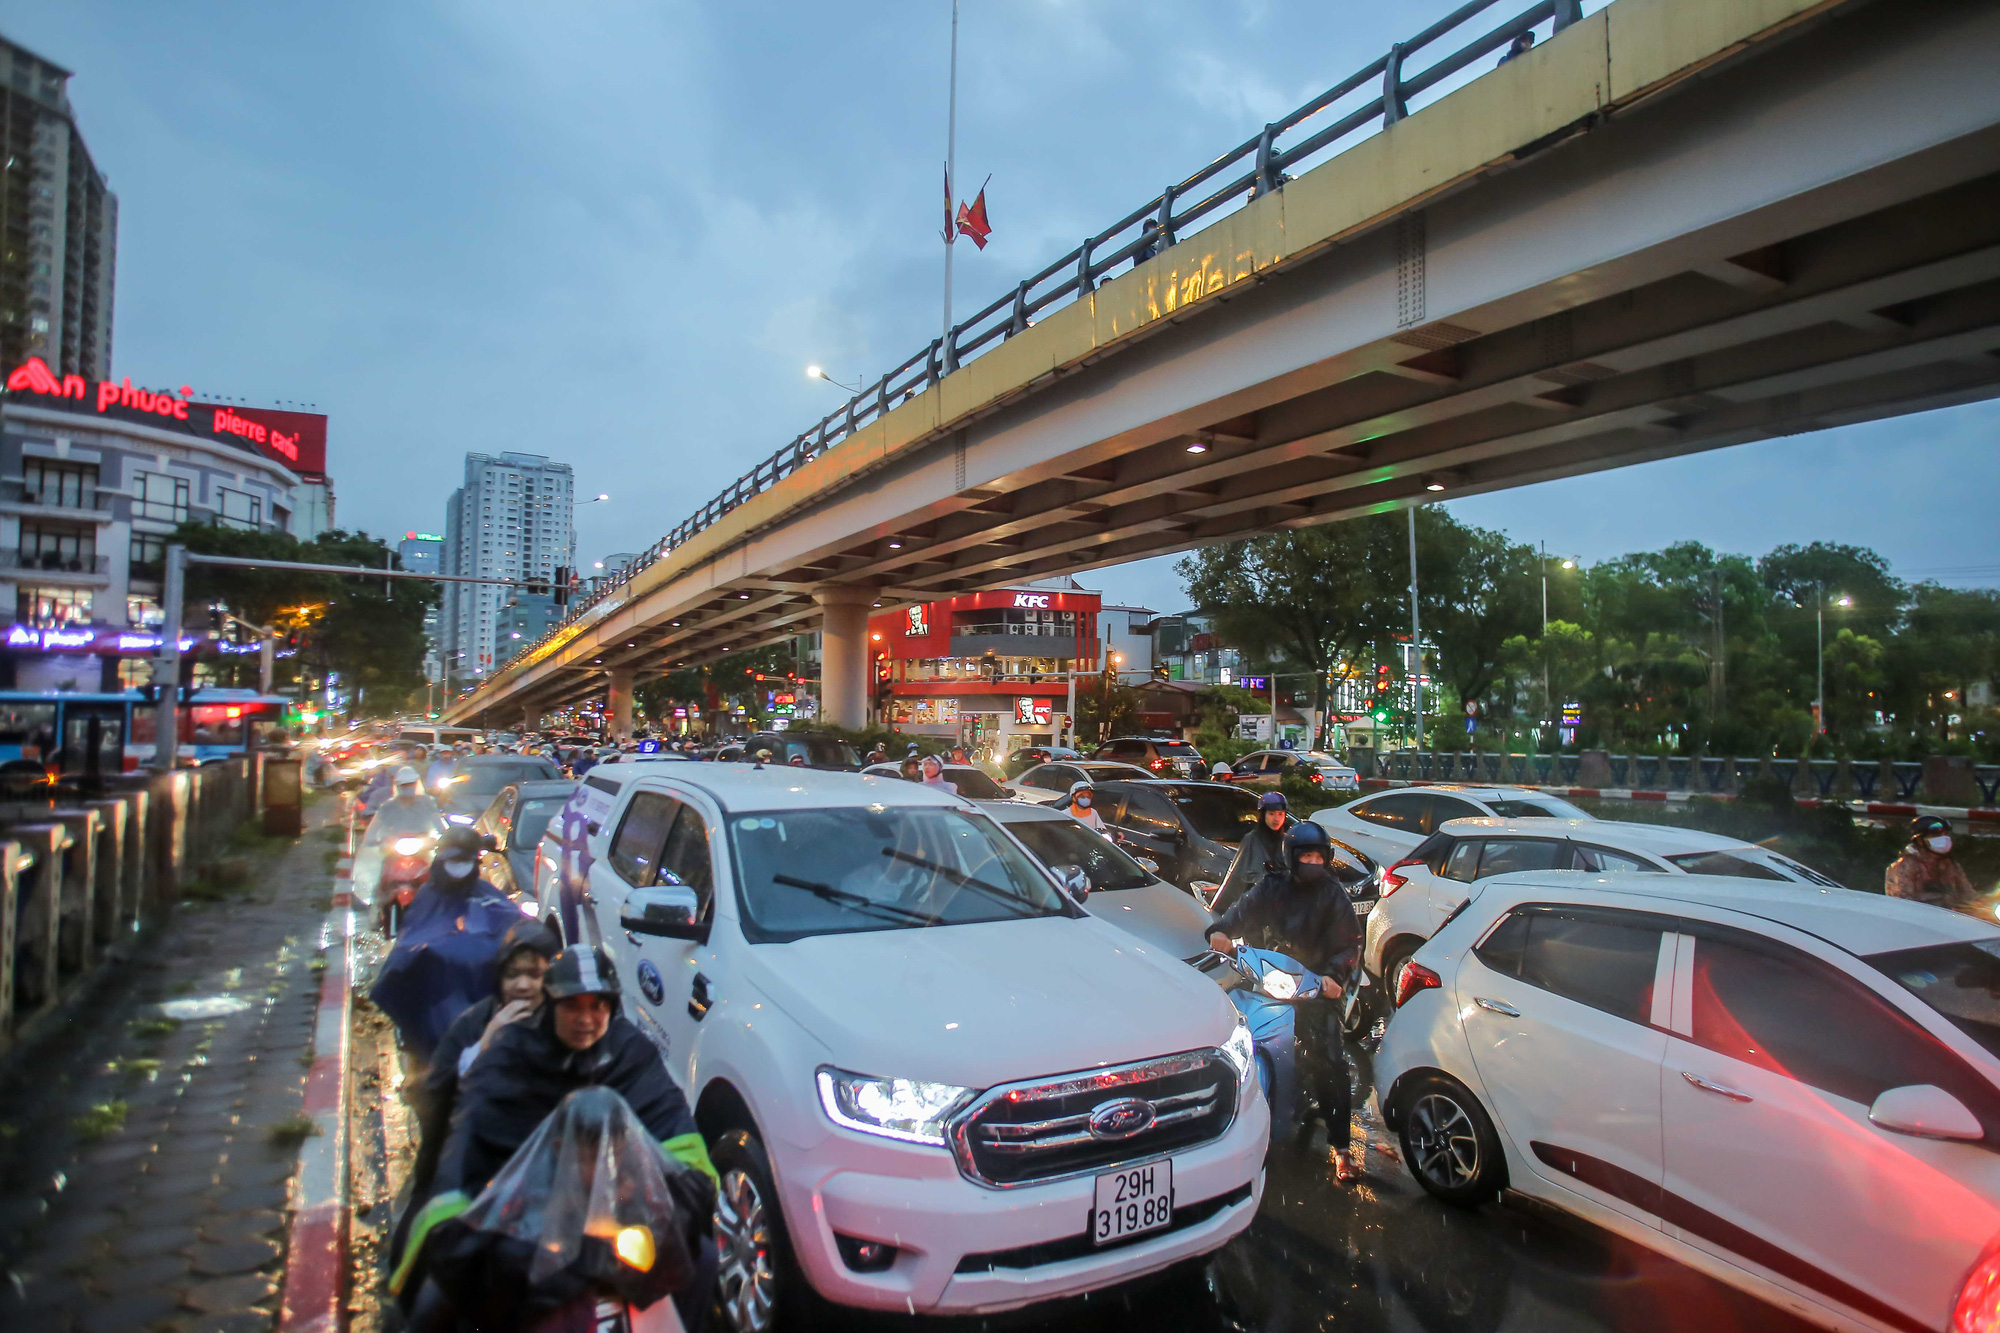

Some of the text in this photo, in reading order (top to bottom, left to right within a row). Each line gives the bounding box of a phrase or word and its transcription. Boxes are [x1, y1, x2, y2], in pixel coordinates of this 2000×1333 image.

[7, 356, 86, 400] An
[213, 407, 267, 443] pierre
[1013, 594, 1049, 608] KFC
[1115, 1166, 1154, 1203] 29H
[1098, 1195, 1169, 1238] 319.88
